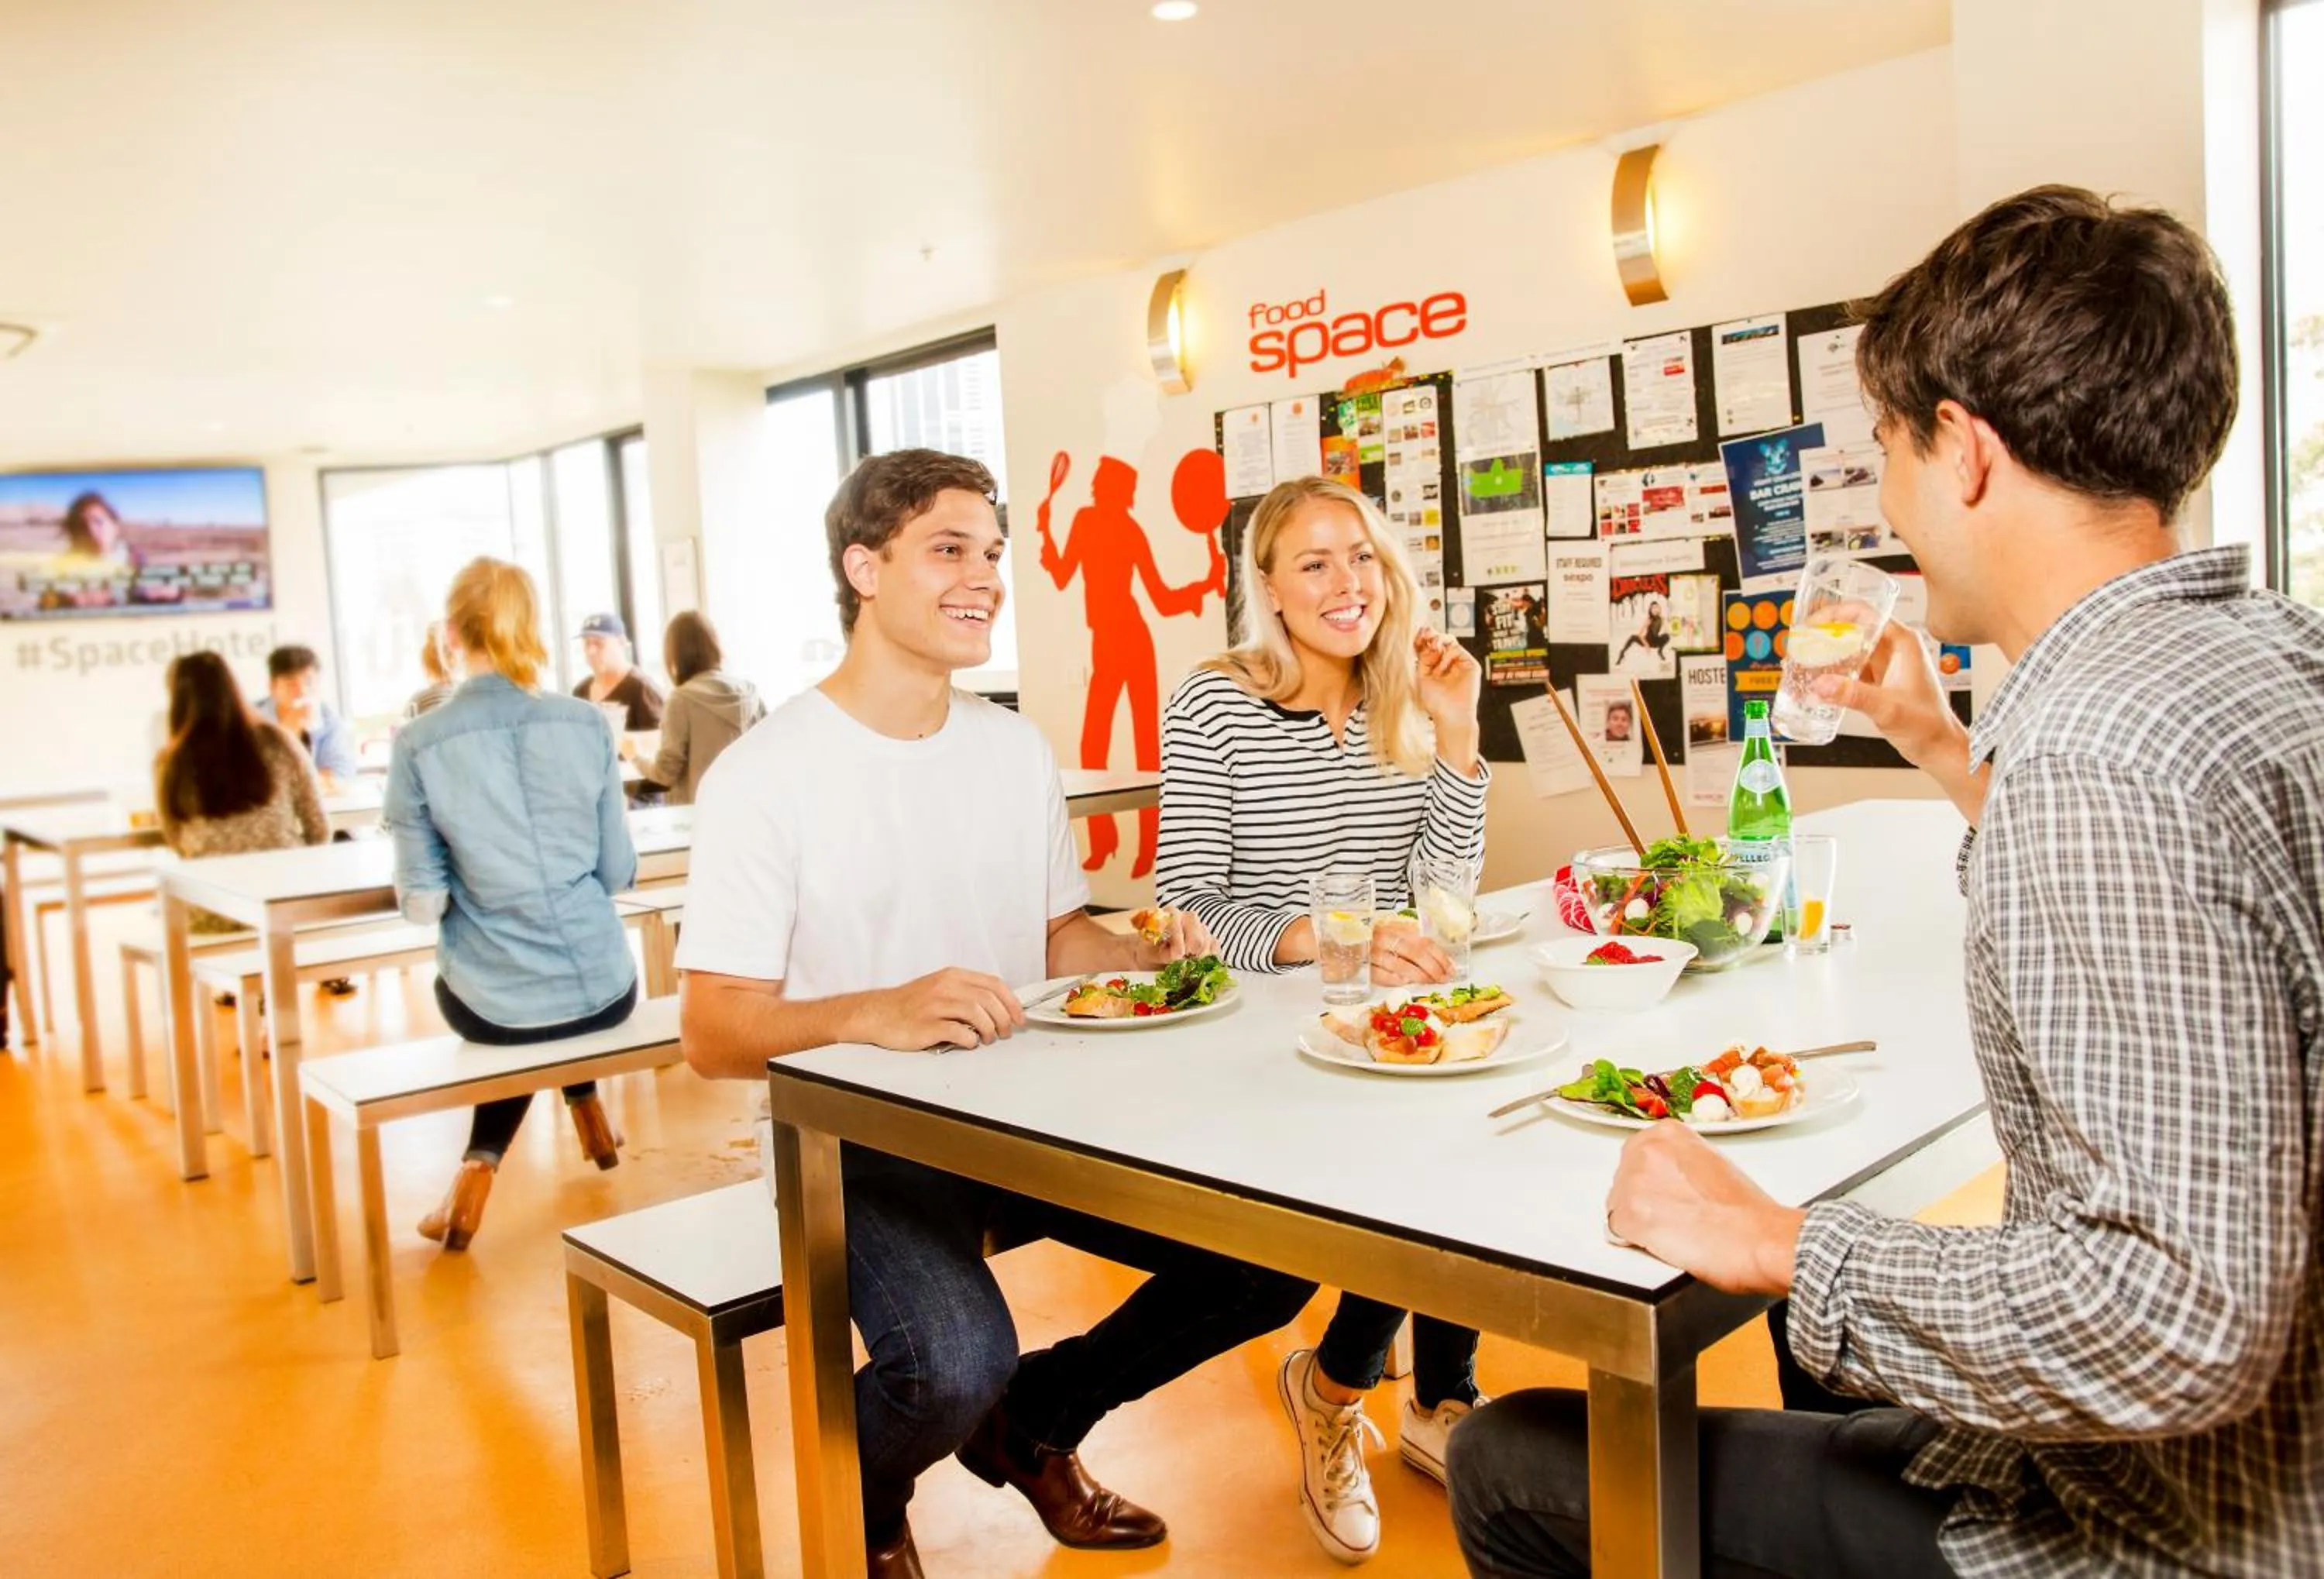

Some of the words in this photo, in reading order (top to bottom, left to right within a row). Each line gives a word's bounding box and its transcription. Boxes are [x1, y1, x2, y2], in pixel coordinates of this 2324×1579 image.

[1248, 288, 1325, 329] food
[1249, 292, 1466, 379] space
[1749, 487, 1772, 501] BAR
[1495, 614, 1513, 629] FIT
[15, 624, 277, 676] #SpaceHotel
